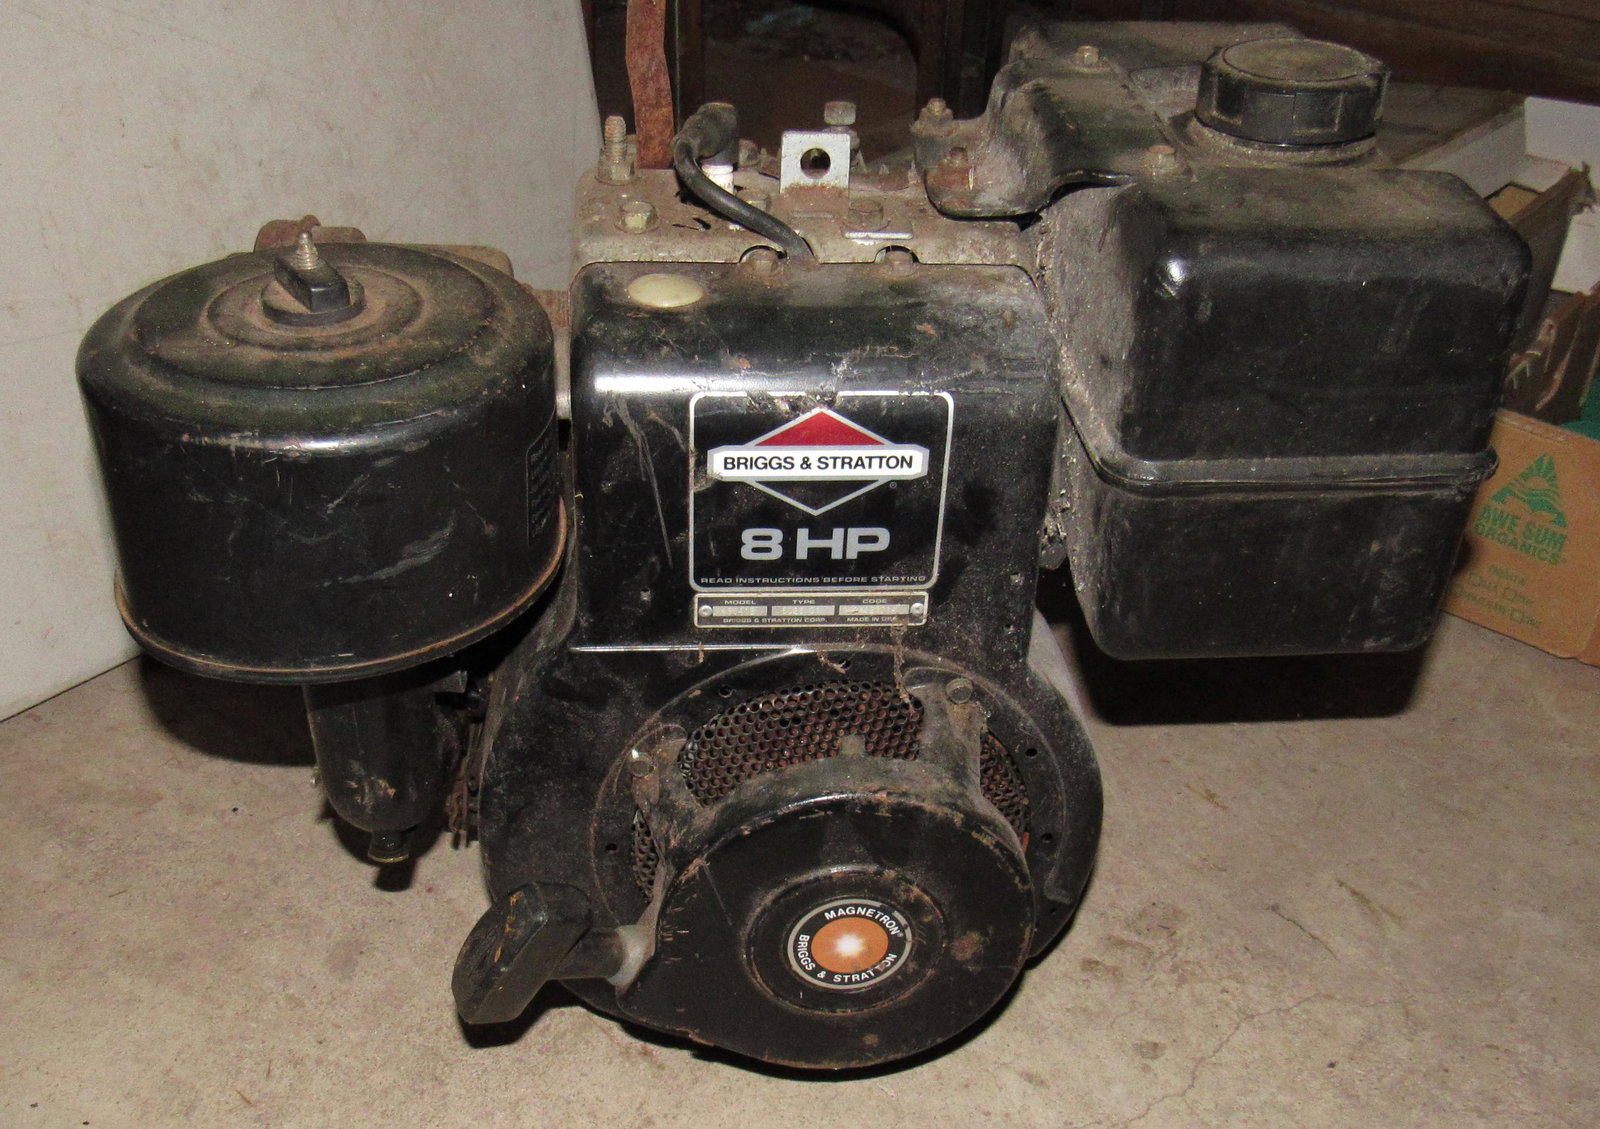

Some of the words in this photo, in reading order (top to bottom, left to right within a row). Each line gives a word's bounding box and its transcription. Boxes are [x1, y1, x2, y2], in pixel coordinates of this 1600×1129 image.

[723, 455, 795, 470] BRIGGS
[799, 456, 812, 469] &
[816, 454, 914, 470] STRATTON
[740, 528, 784, 561] 8
[795, 527, 890, 560] HP
[1473, 521, 1560, 565] ORGANICS
[1478, 505, 1520, 533] AWE
[1523, 521, 1567, 552] SUM
[735, 576, 820, 584] INSTRUCTIONS
[871, 575, 926, 583] STARTING
[797, 934, 816, 971] BRIGGS
[817, 970, 826, 979] &
